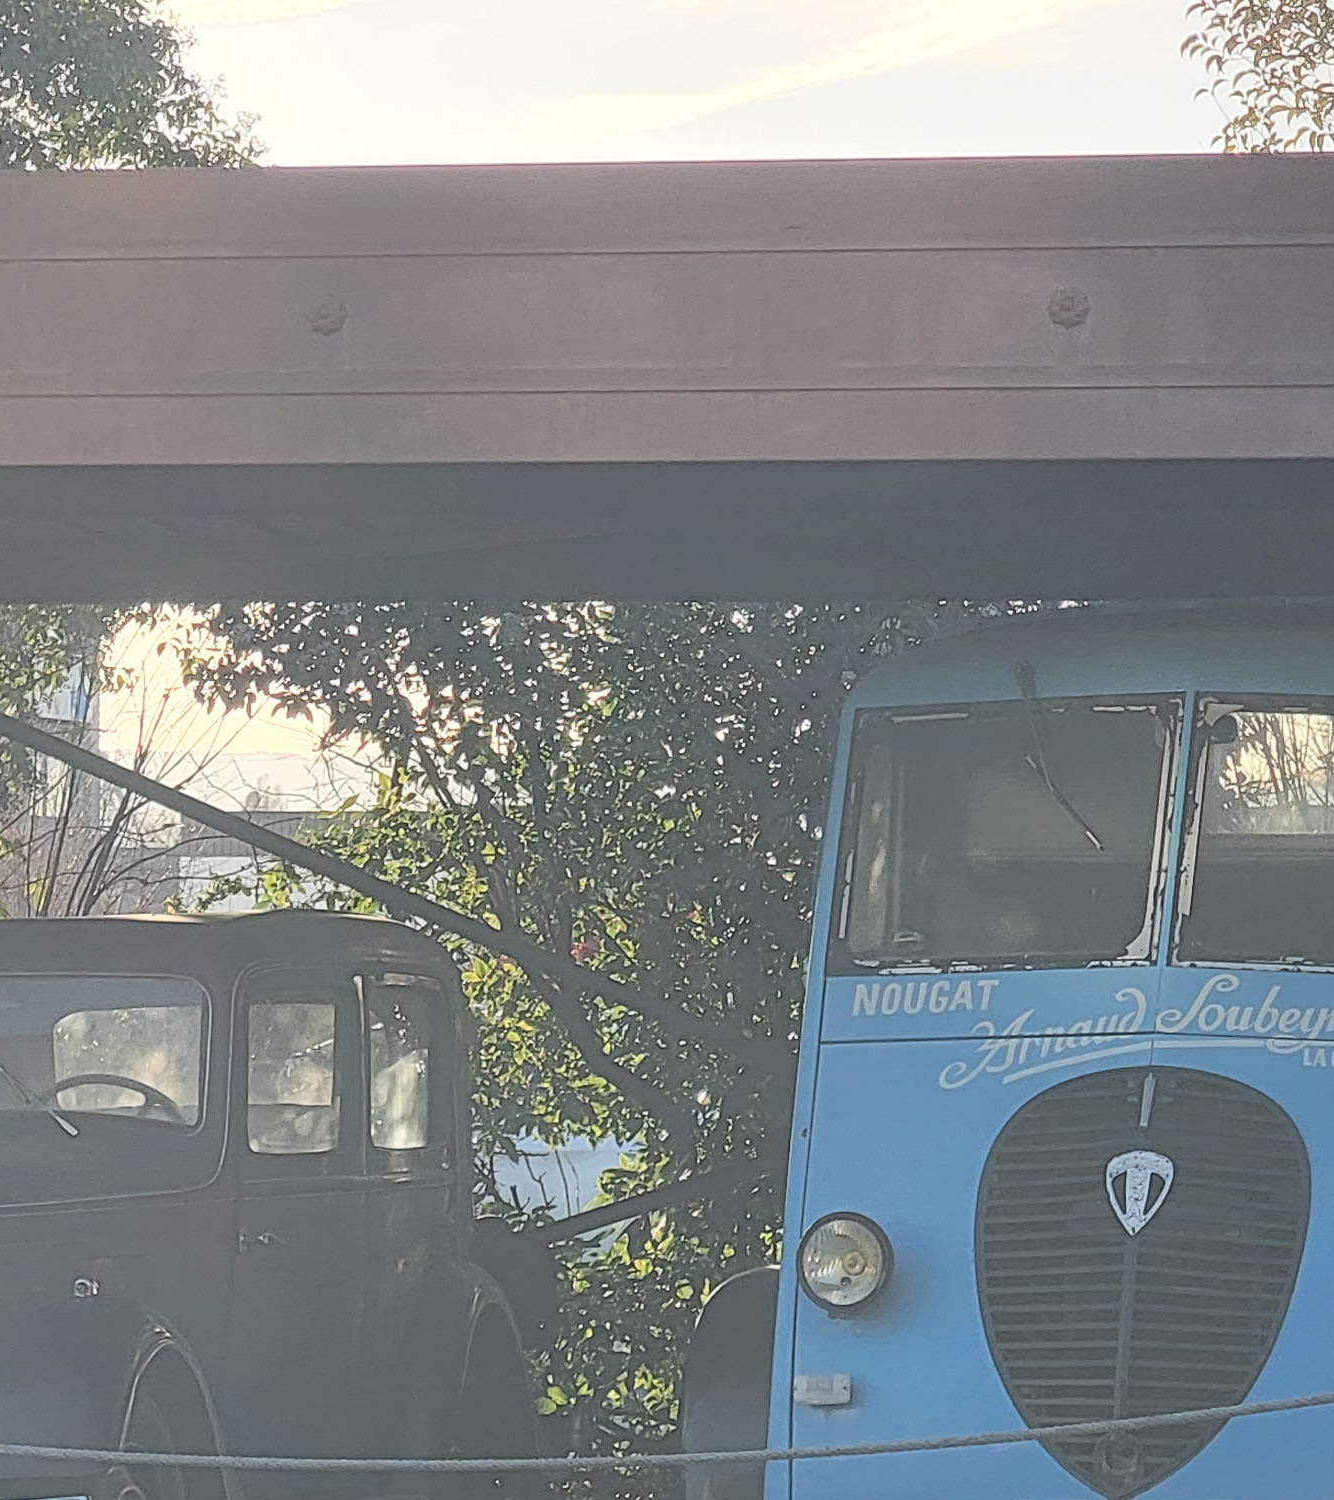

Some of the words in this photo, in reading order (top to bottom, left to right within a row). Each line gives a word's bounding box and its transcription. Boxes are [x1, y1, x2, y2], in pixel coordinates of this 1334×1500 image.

[852, 979, 1000, 1016] NOUGAT
[939, 987, 1147, 1089] Arnaud
[1303, 1048, 1327, 1068] LA
